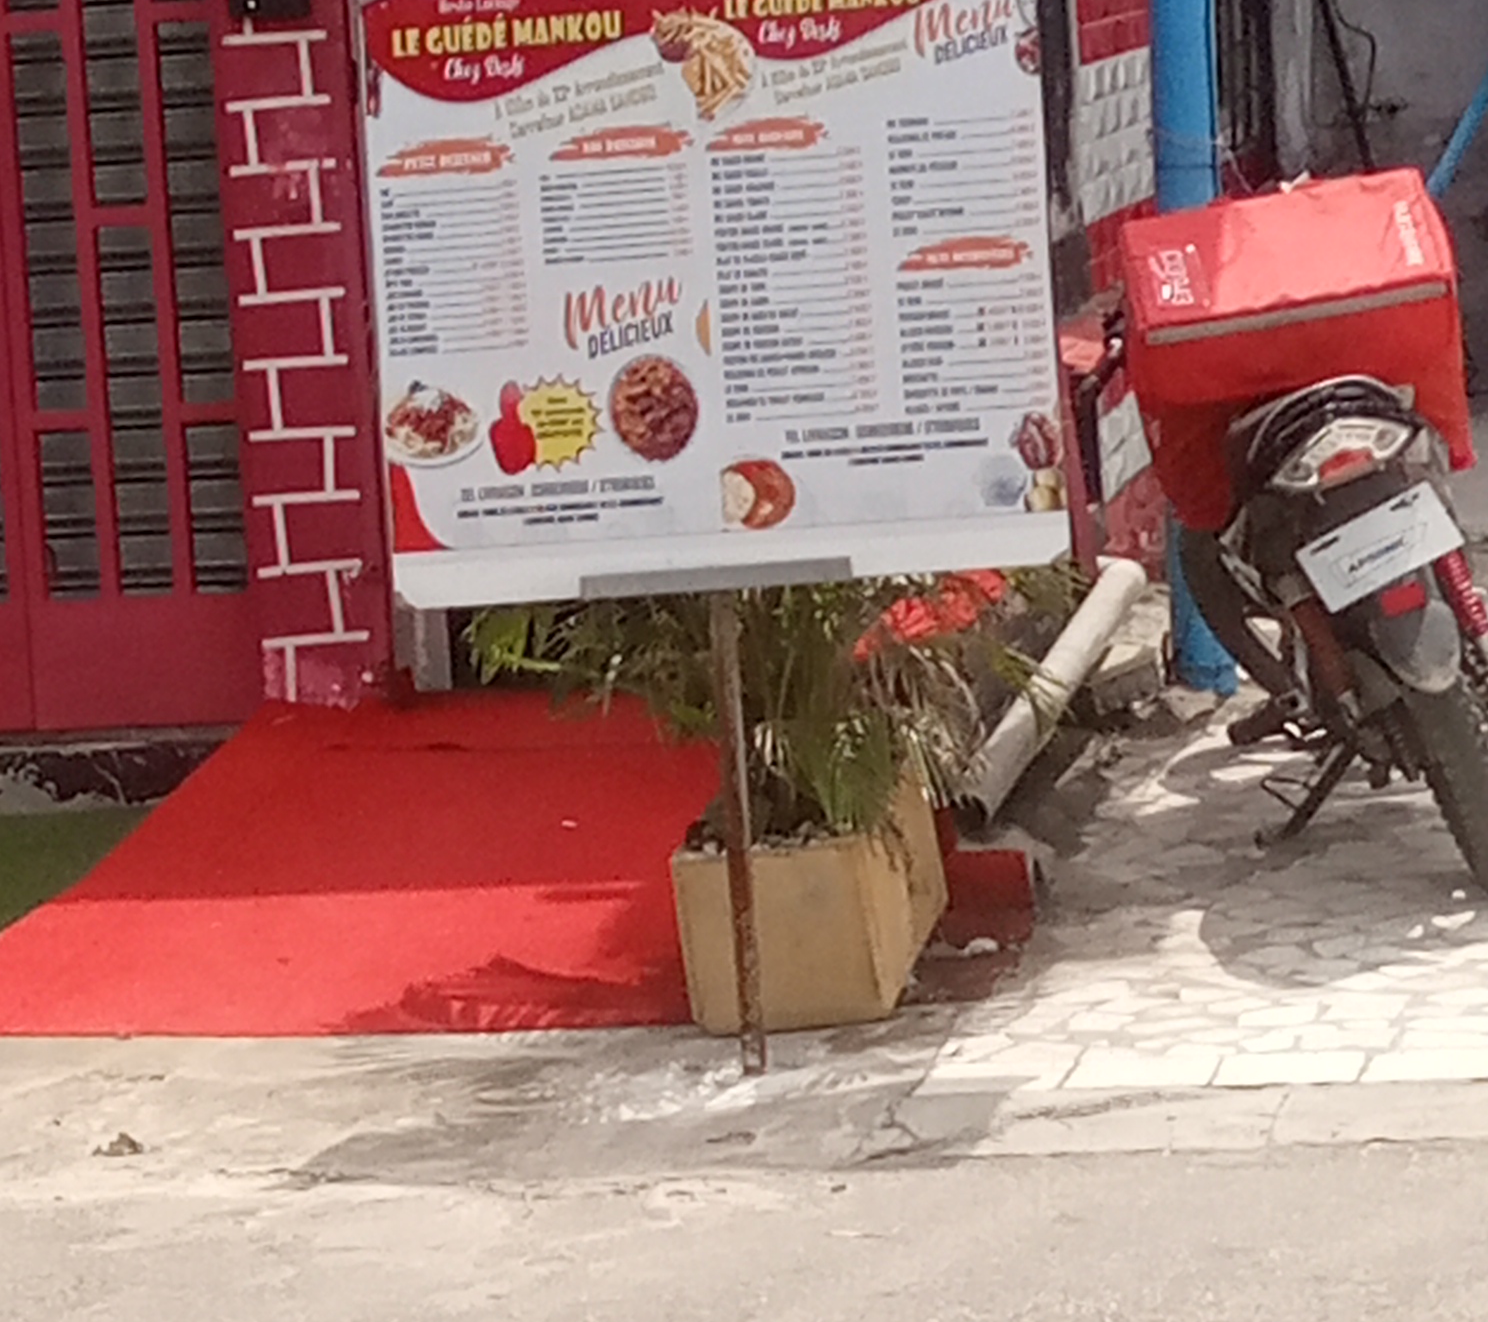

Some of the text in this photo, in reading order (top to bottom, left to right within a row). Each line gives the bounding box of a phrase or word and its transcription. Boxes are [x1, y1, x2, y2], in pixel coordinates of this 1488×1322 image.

[392, 9, 623, 58] LE GUÉDÉ MANKOU
[564, 275, 682, 351] Menu
